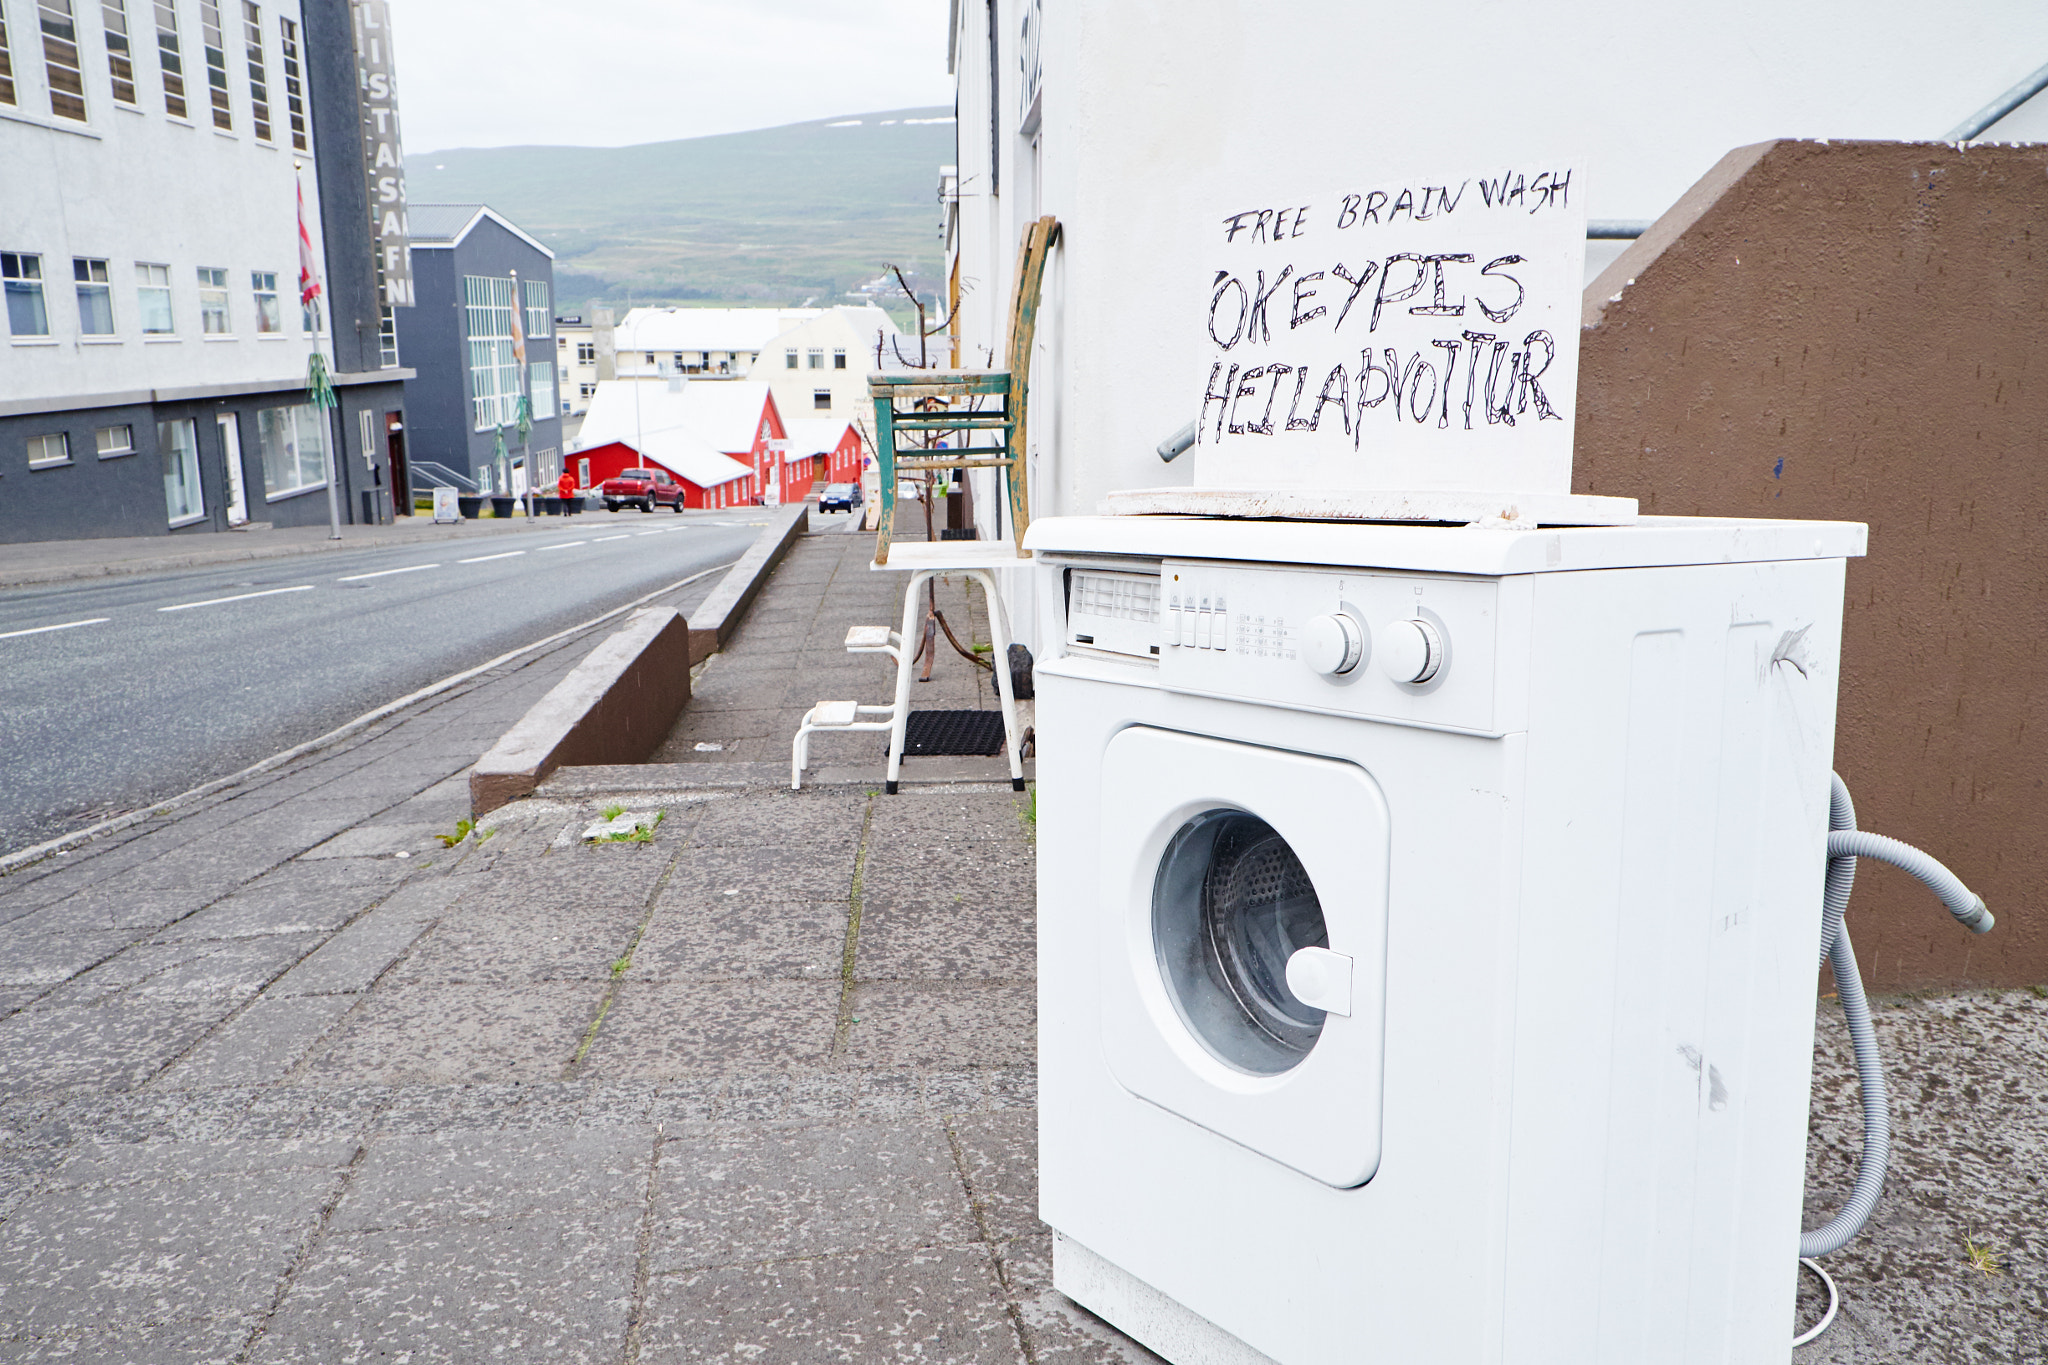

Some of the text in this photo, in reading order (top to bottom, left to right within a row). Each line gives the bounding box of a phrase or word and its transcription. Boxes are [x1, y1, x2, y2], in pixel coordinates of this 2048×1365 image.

[363, 2, 407, 304] LISTASAFN
[1222, 168, 1572, 244] FREE BRAIN WASH
